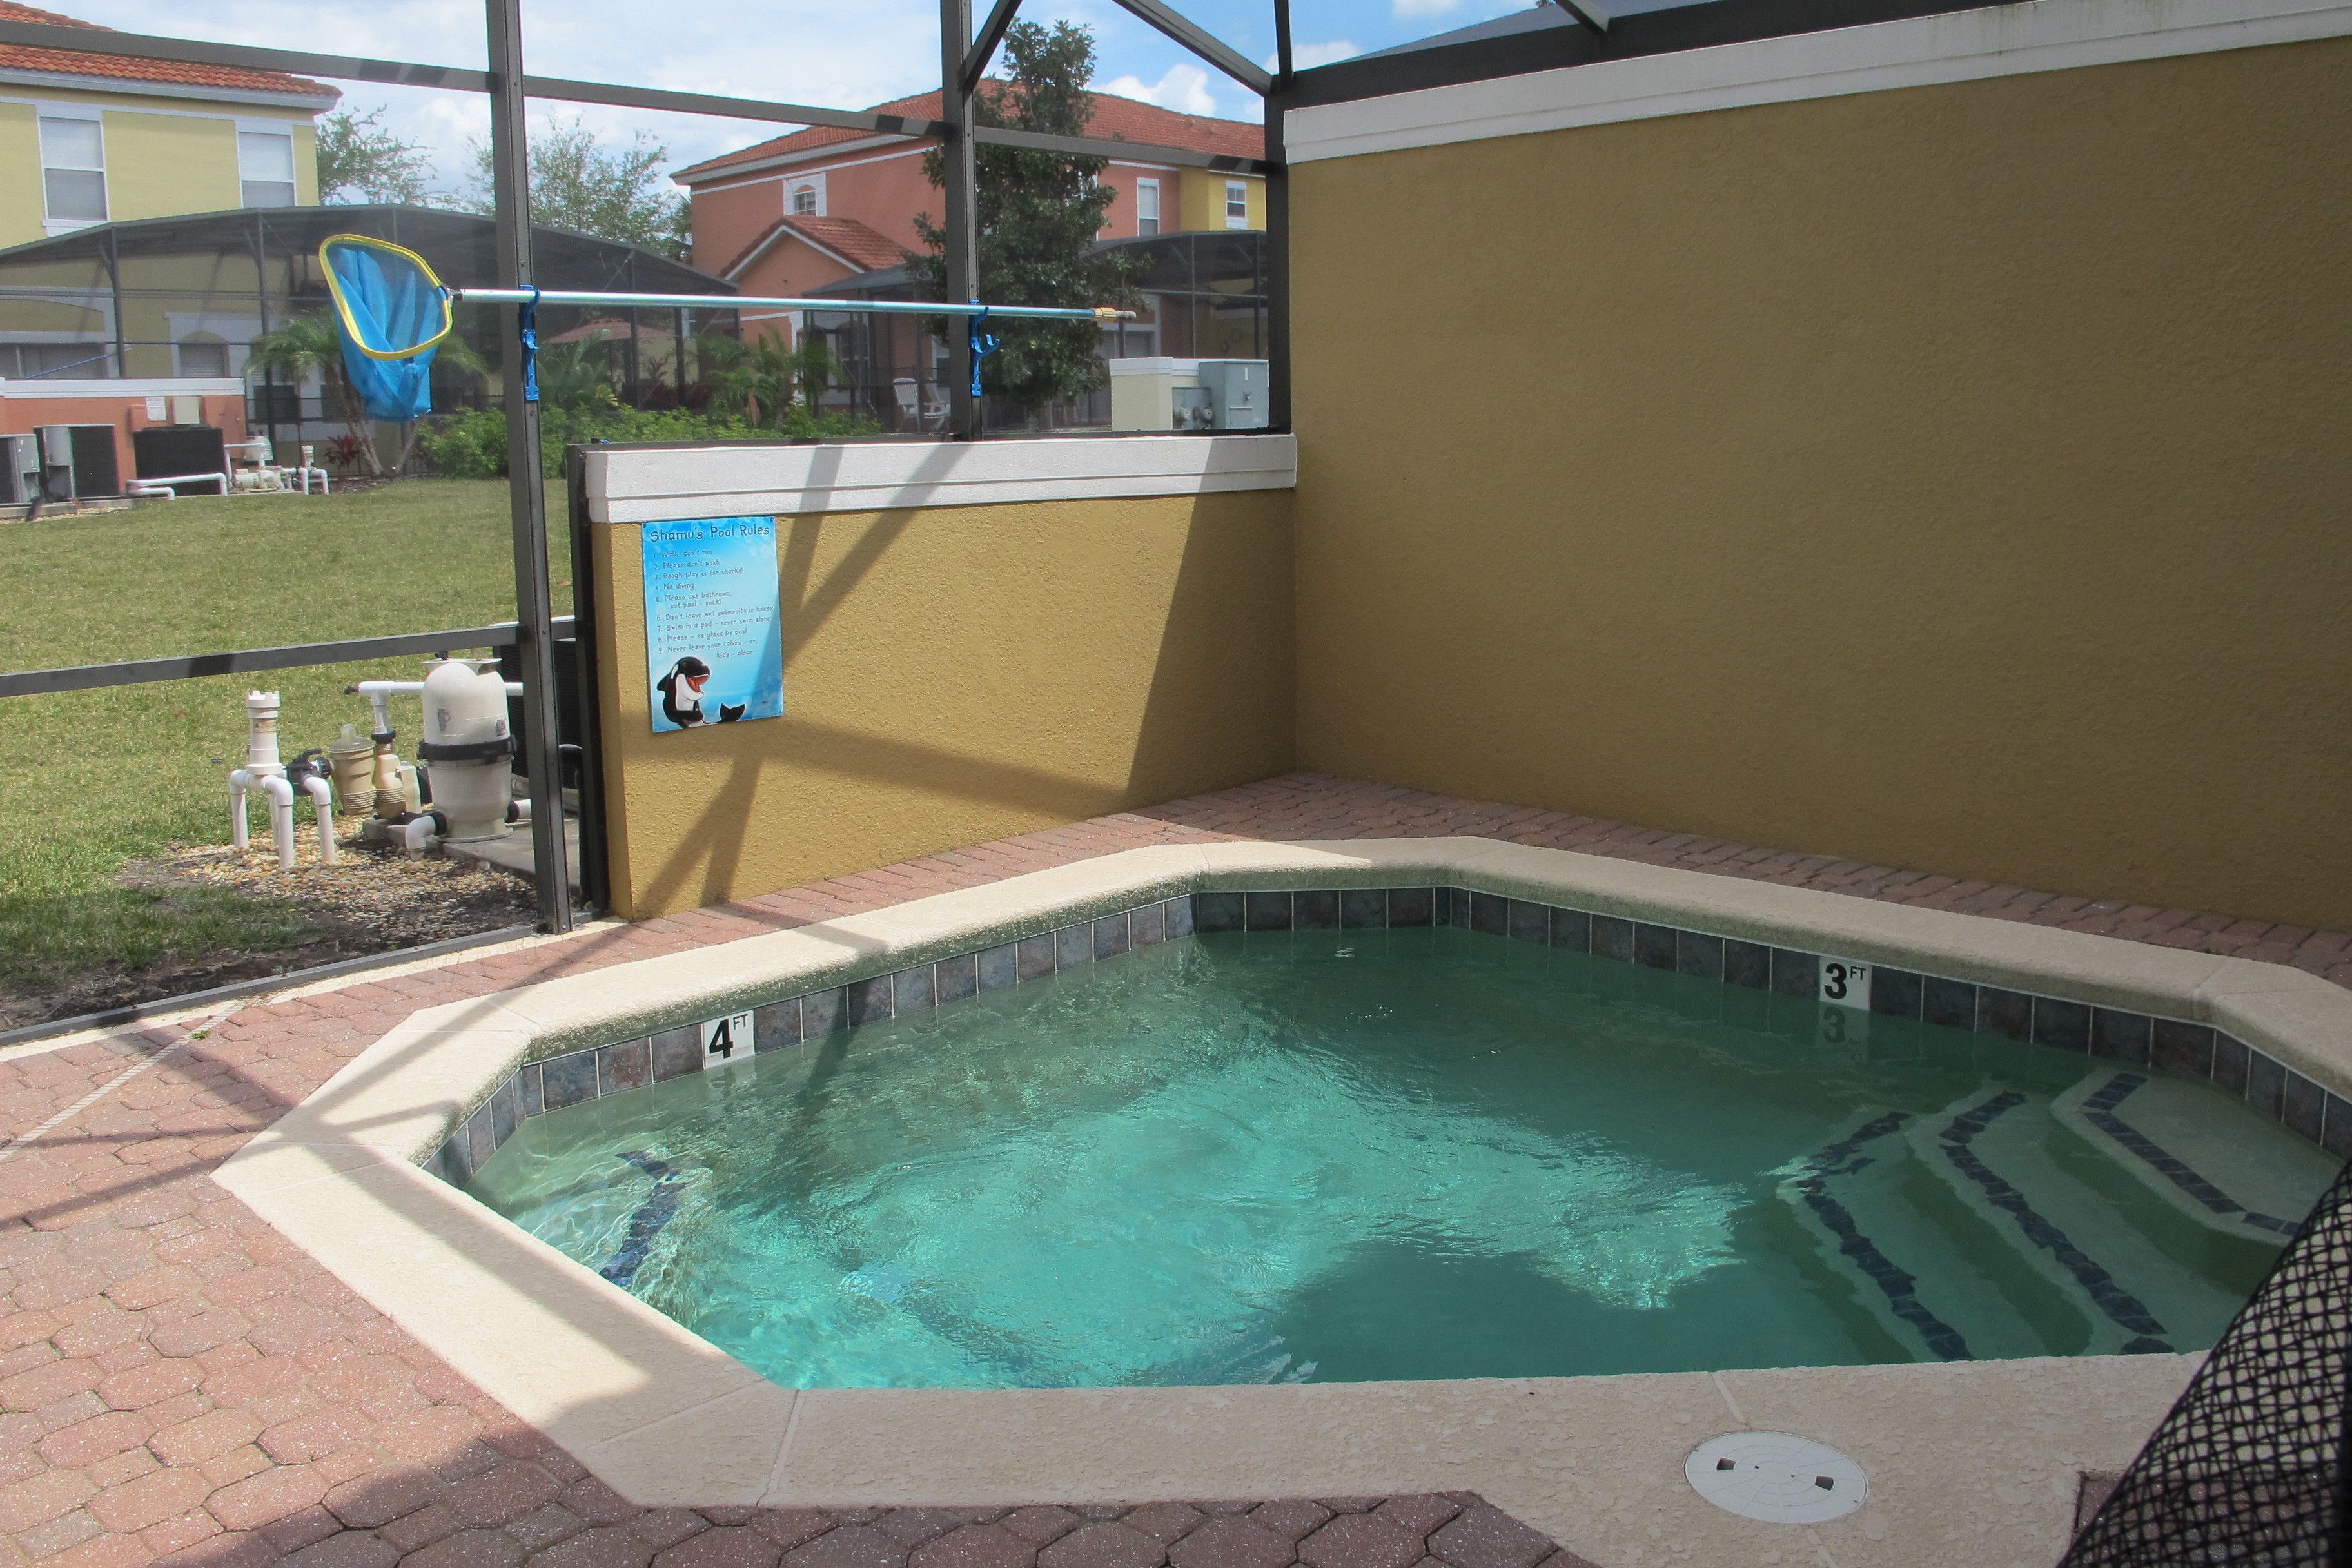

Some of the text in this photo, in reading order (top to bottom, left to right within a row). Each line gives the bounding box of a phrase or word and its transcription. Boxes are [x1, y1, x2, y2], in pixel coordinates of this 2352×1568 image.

[651, 523, 770, 542] Shamu's Pool Rules
[705, 559, 720, 567] push
[663, 572, 683, 580] Rough
[685, 571, 698, 579] play
[721, 567, 743, 575] sharks!
[676, 582, 694, 591] diving
[683, 600, 697, 609] pool
[705, 598, 722, 607] yuck!
[718, 609, 747, 617] swimsuits
[701, 621, 712, 629] pod
[707, 631, 723, 640] glass
[734, 627, 747, 636] pool
[1825, 963, 1867, 1000] 3 FT
[709, 1014, 748, 1059] 4 FT
